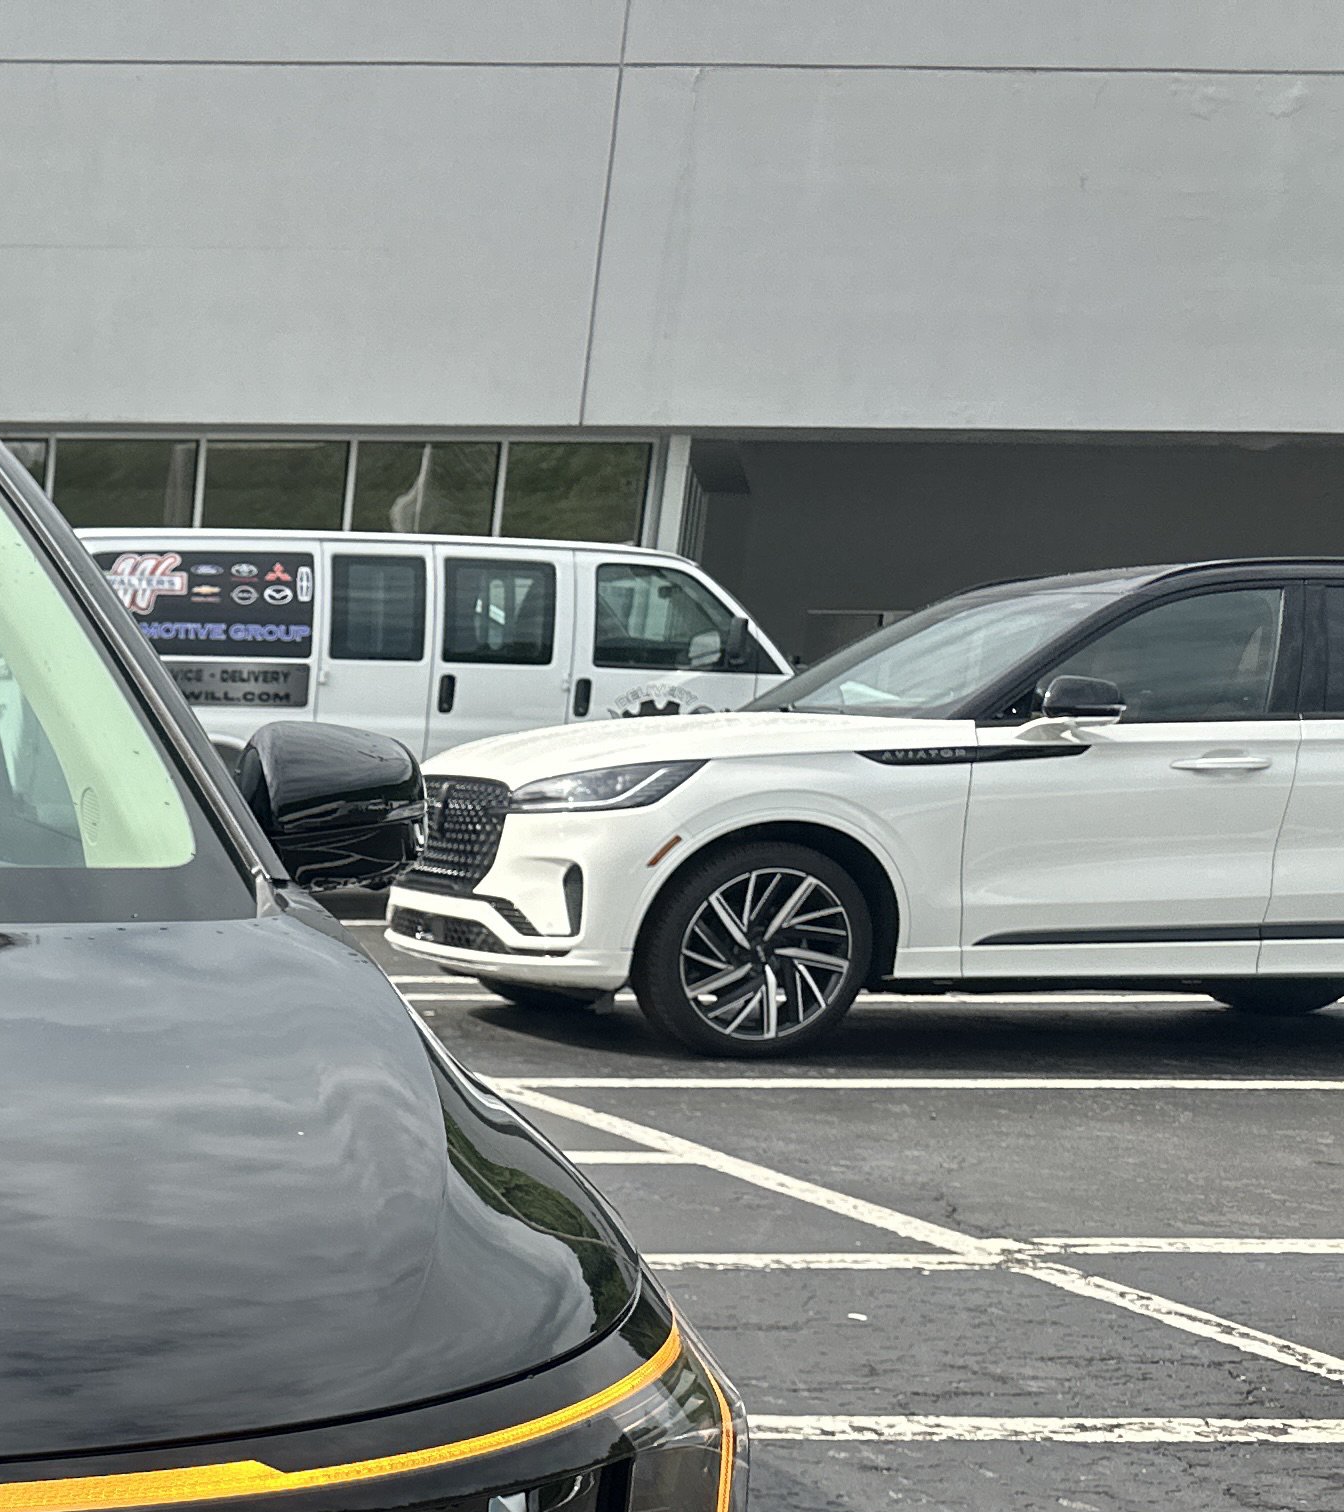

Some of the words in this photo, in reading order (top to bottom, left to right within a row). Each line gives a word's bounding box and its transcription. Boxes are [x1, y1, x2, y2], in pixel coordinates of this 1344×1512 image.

[138, 621, 227, 640] MOTIVE
[228, 623, 310, 642] GROUP
[171, 668, 203, 682] VICE
[220, 670, 291, 684] DELIVERY
[183, 691, 291, 702] WILL.COM
[881, 749, 966, 761] AVIATOR
